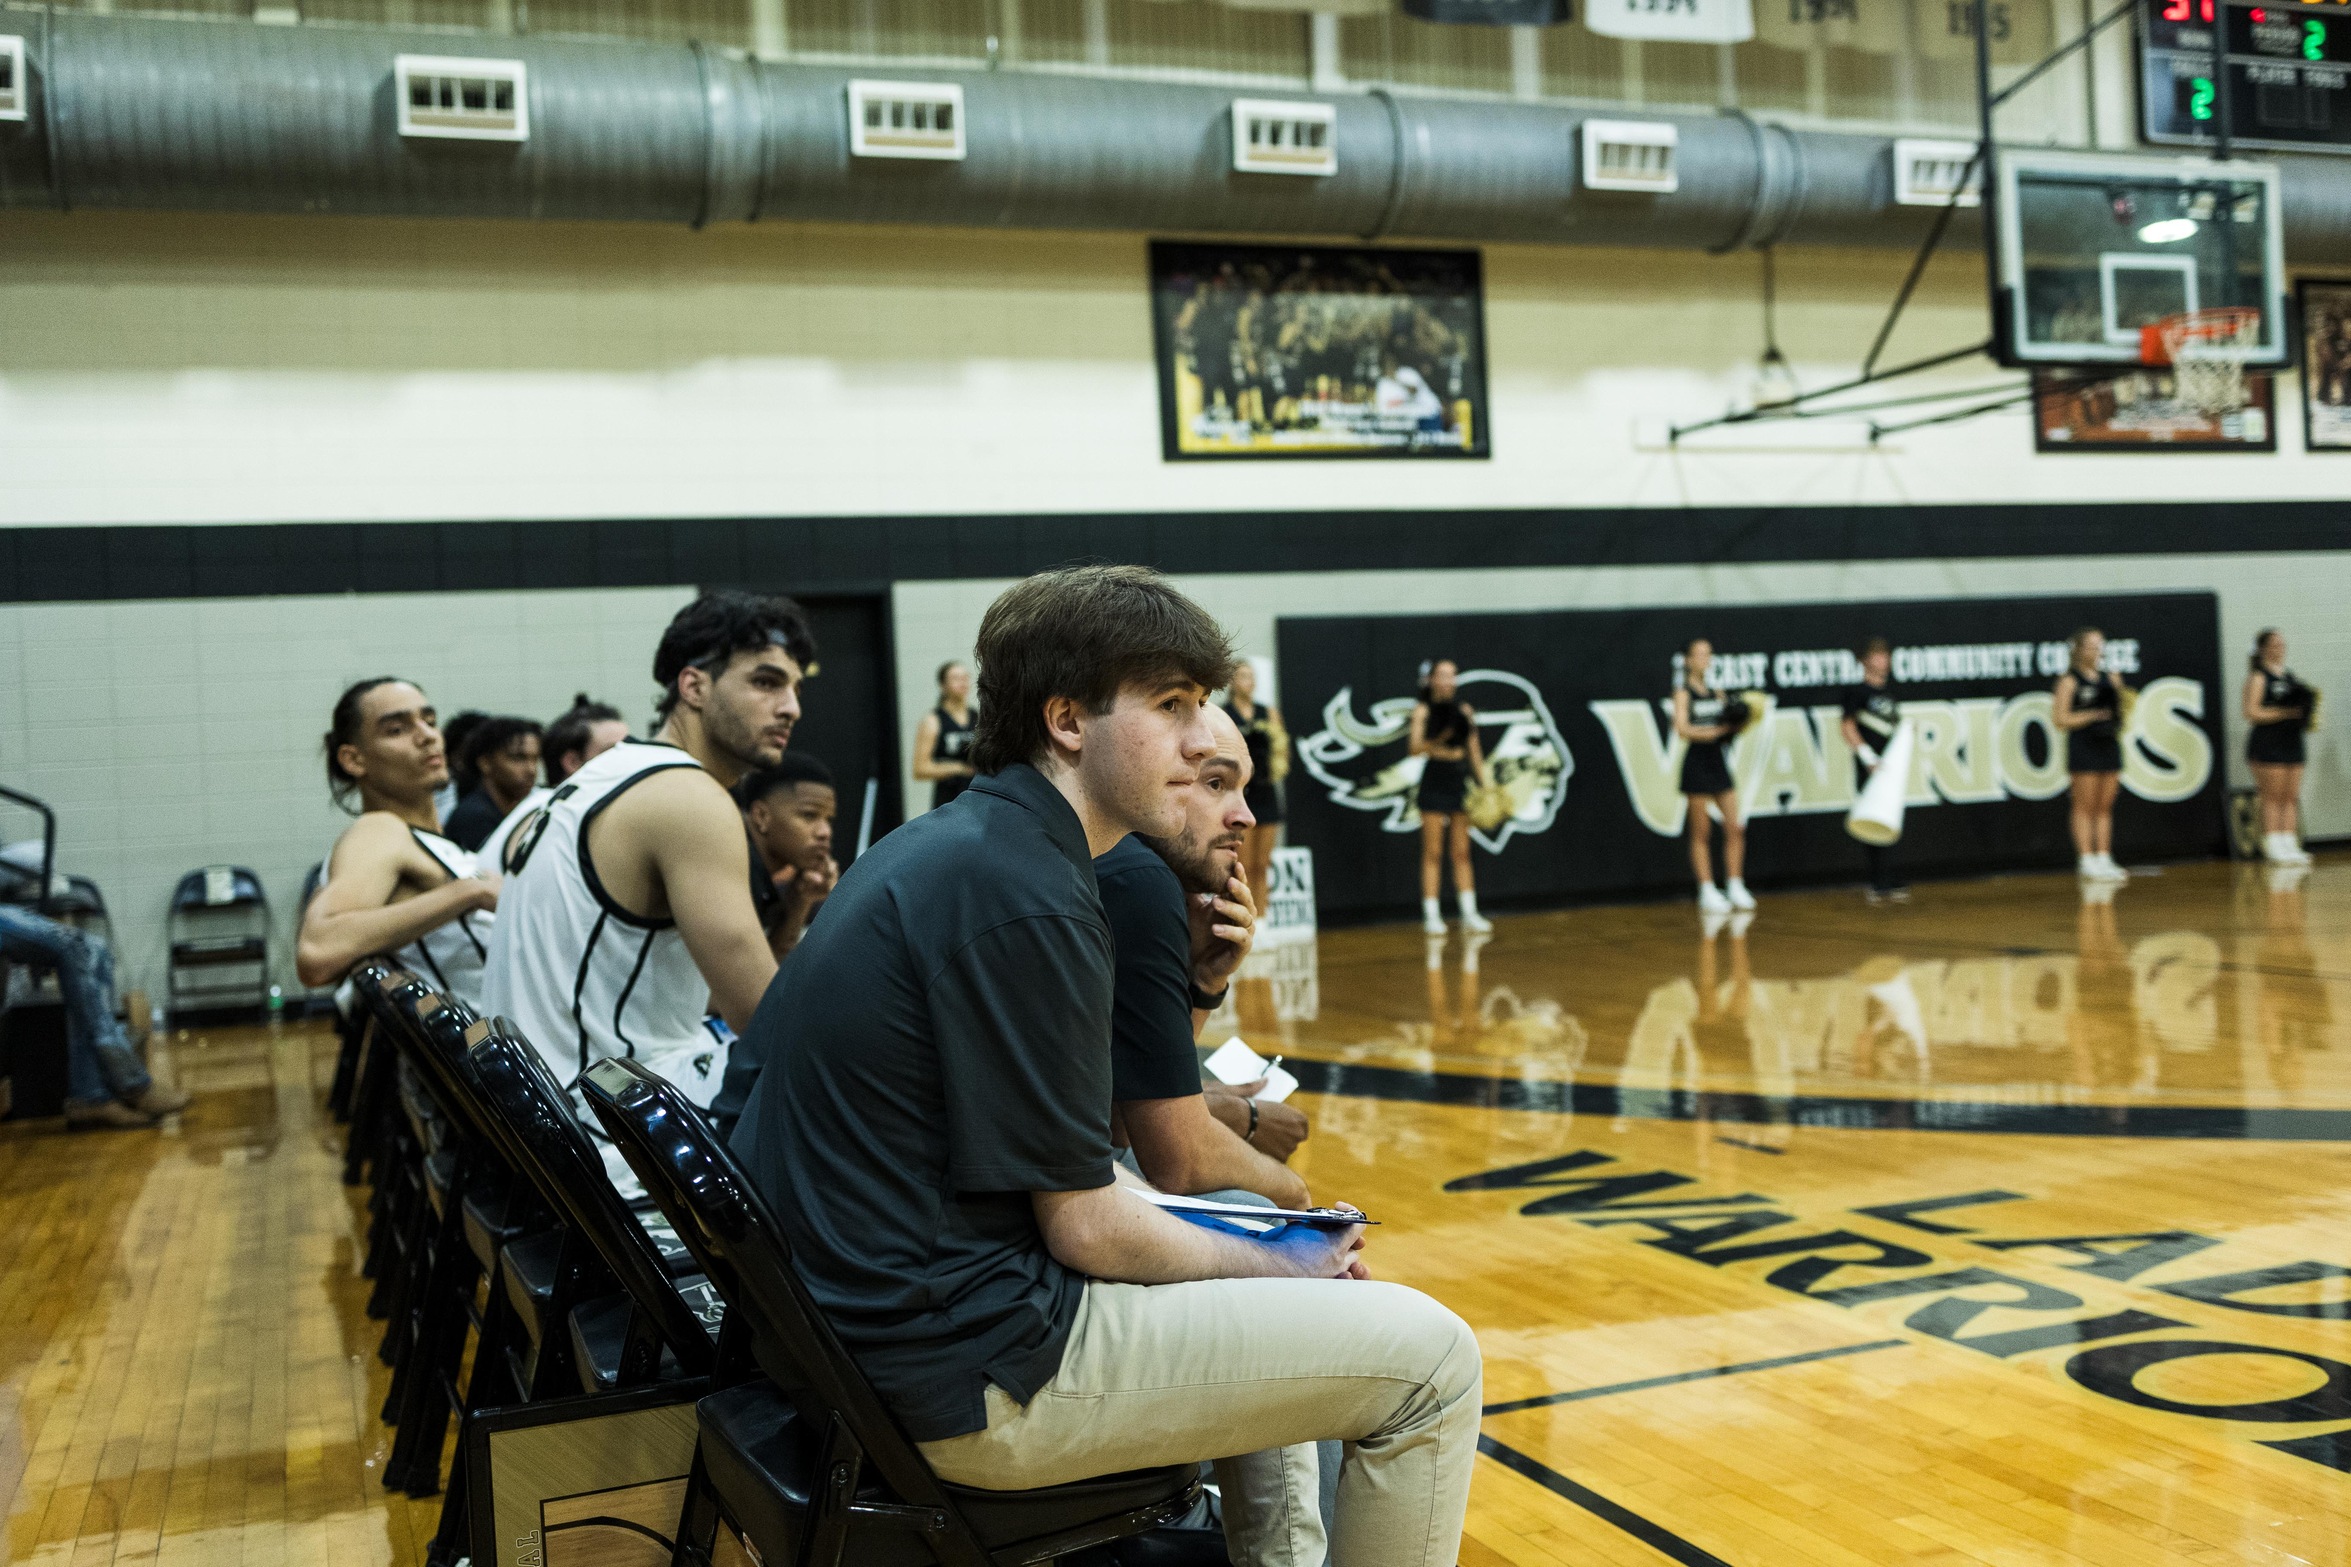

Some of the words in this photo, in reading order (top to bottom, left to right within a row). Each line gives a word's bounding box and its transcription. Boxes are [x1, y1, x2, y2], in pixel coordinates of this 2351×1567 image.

[2303, 19, 2327, 61] 2
[2190, 77, 2216, 121] 2
[1772, 649, 1867, 688] CENTRA
[1890, 640, 2034, 683] COMMUNITY
[2036, 638, 2141, 678] COGE
[1587, 674, 2214, 838] WARIOS
[1442, 1149, 2351, 1475] WARRIO
